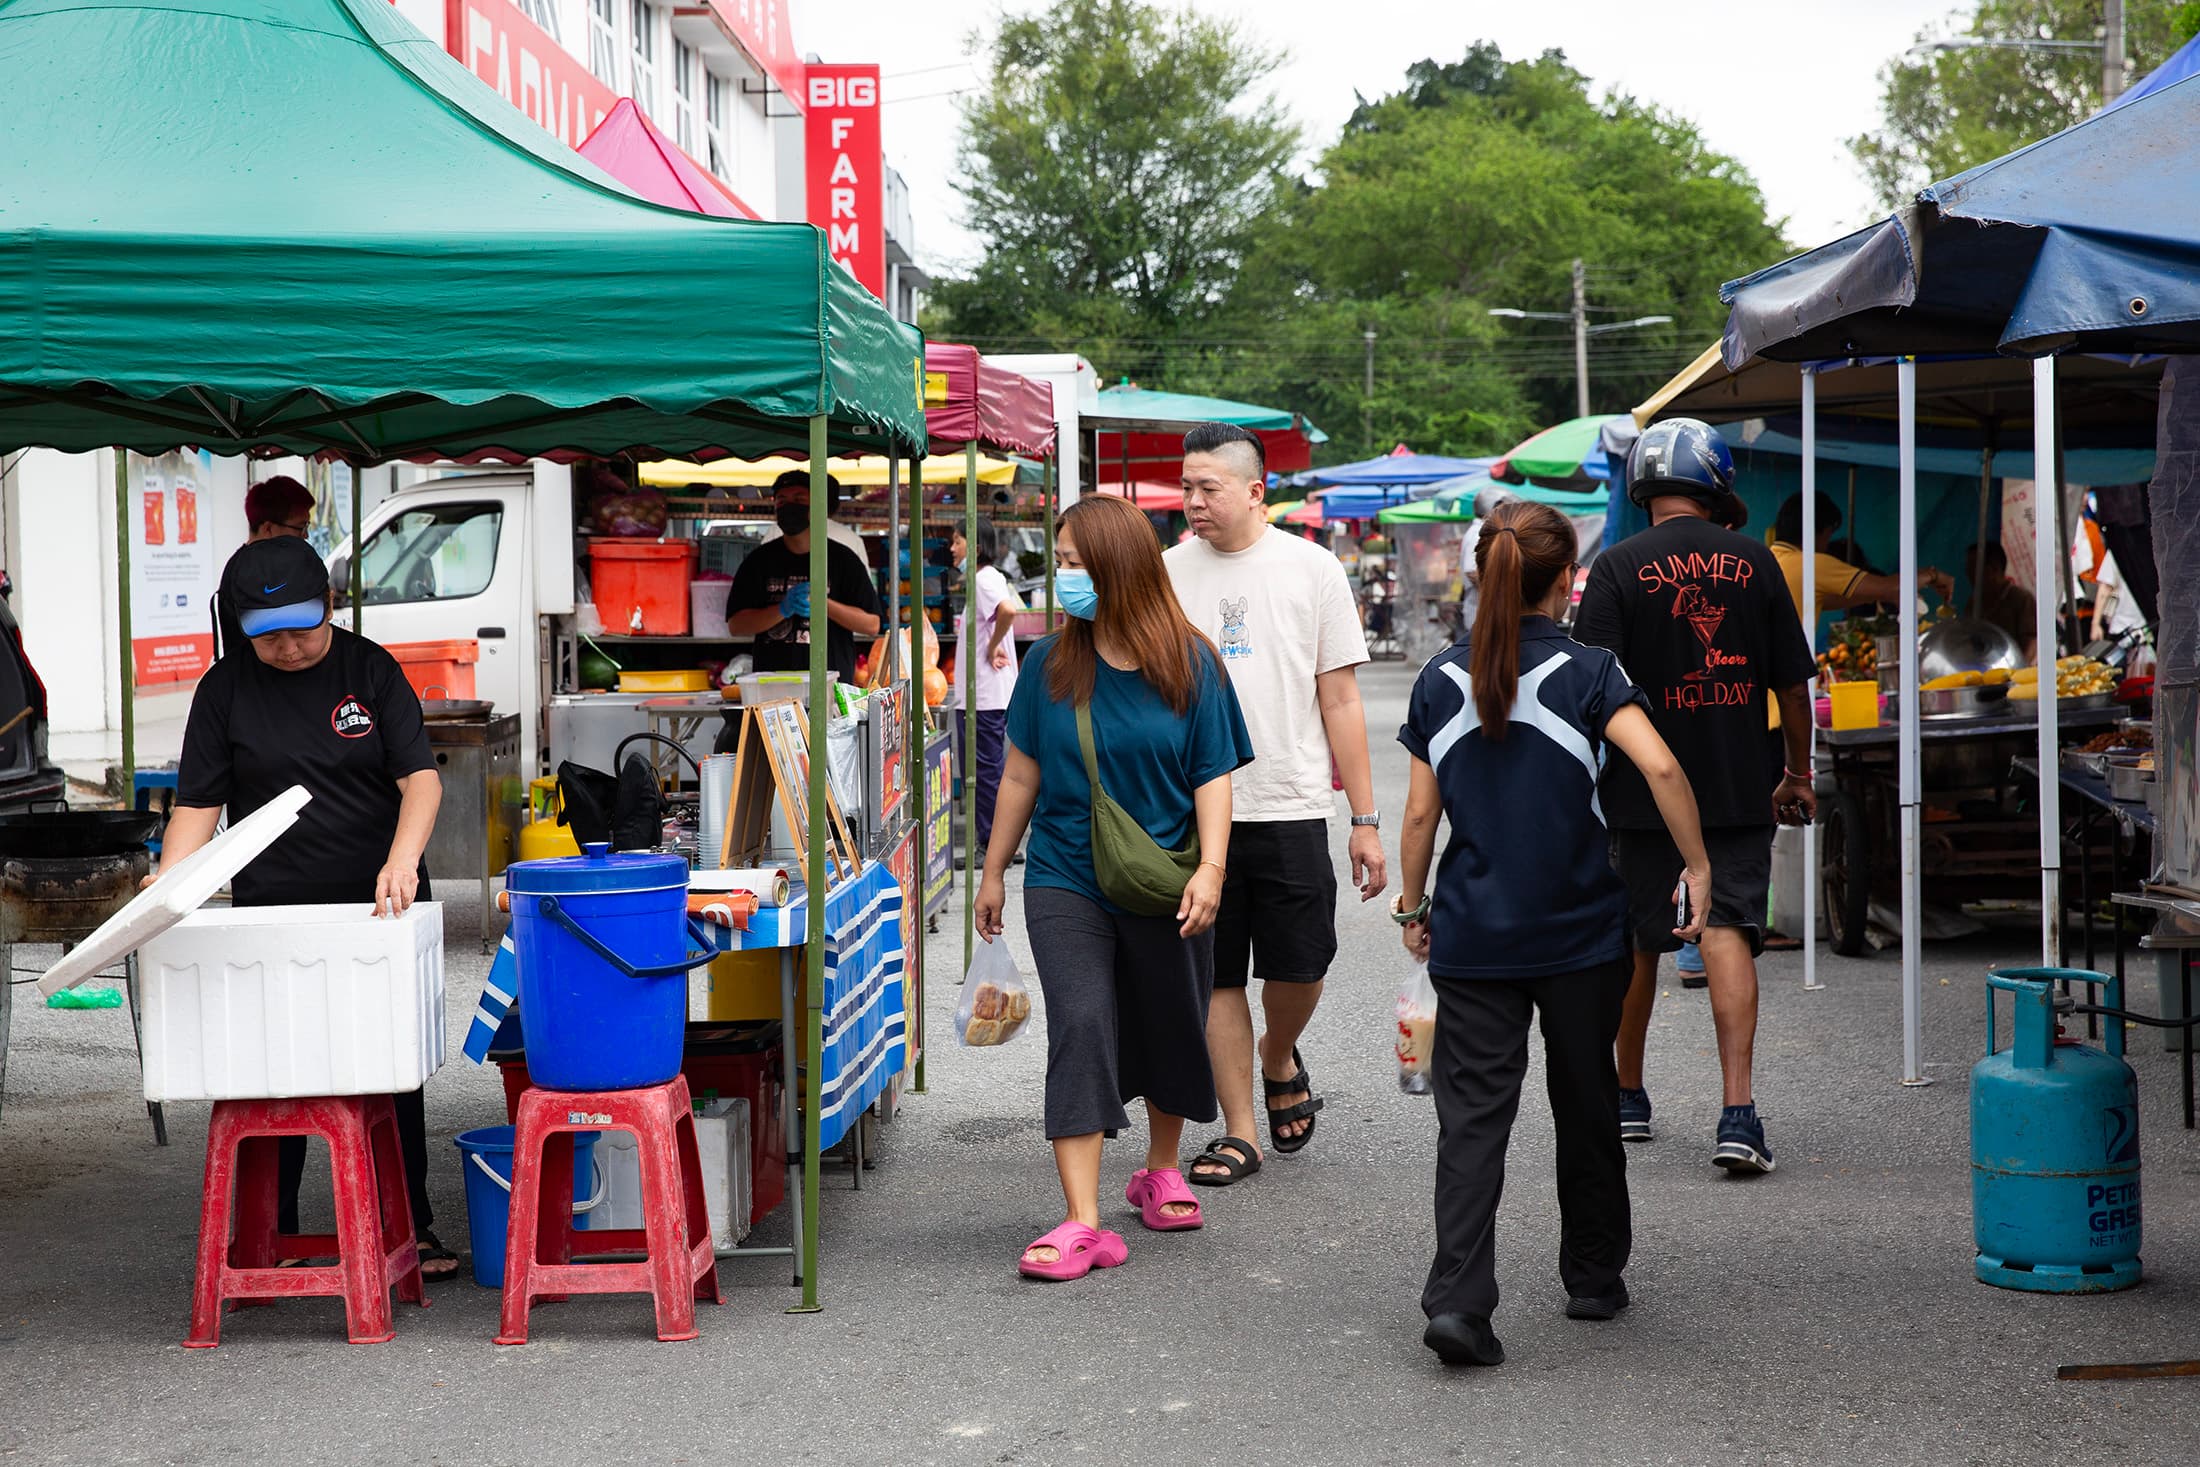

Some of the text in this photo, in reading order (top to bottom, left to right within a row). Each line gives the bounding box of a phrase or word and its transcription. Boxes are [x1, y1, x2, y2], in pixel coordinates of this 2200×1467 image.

[809, 76, 876, 107] BIG
[1638, 552, 1753, 593] SUMMER
[2089, 1234, 2115, 1248] NET
